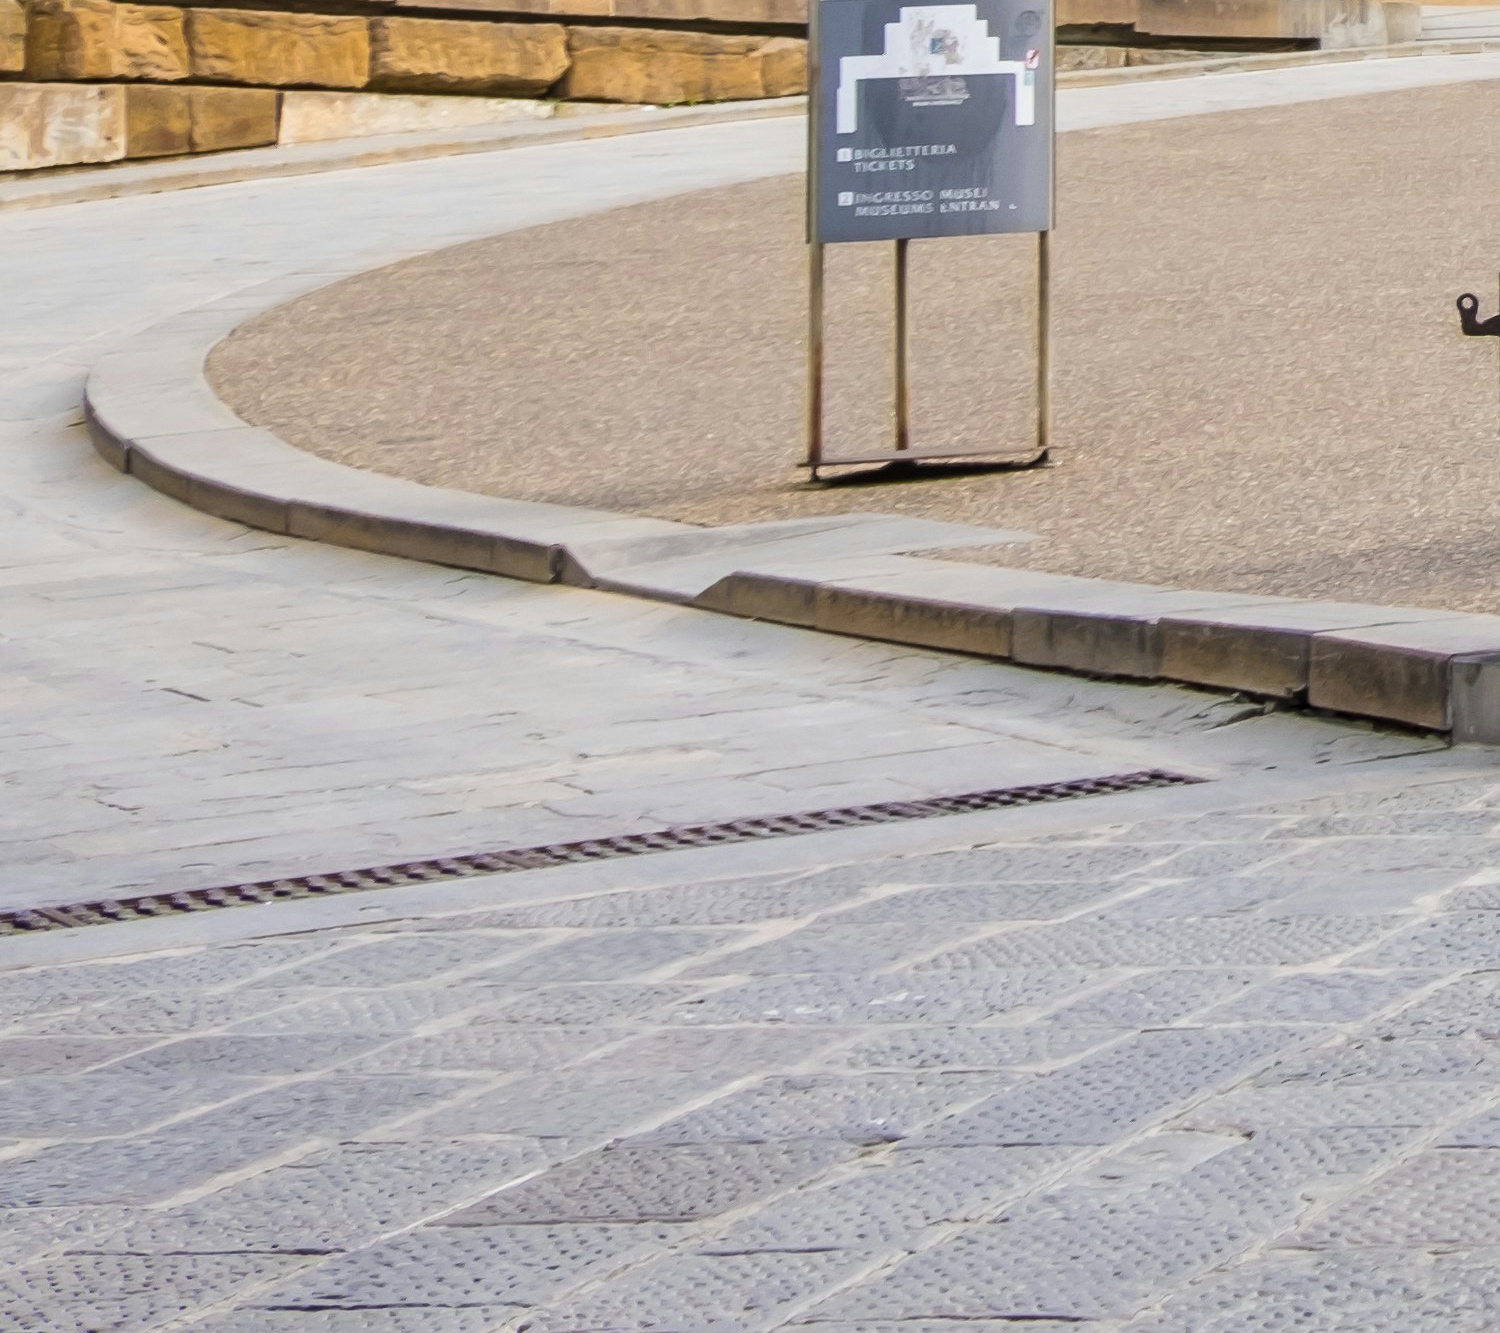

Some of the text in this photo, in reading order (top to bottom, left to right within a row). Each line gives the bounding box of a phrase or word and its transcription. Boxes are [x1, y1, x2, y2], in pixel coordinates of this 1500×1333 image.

[854, 143, 957, 160] BIGLIETTERIA
[854, 159, 916, 172] TICKETS
[855, 190, 934, 204] INGRESSO
[939, 187, 988, 200] MUSEI
[855, 200, 1017, 216] MUSEUMS ENTRAN
